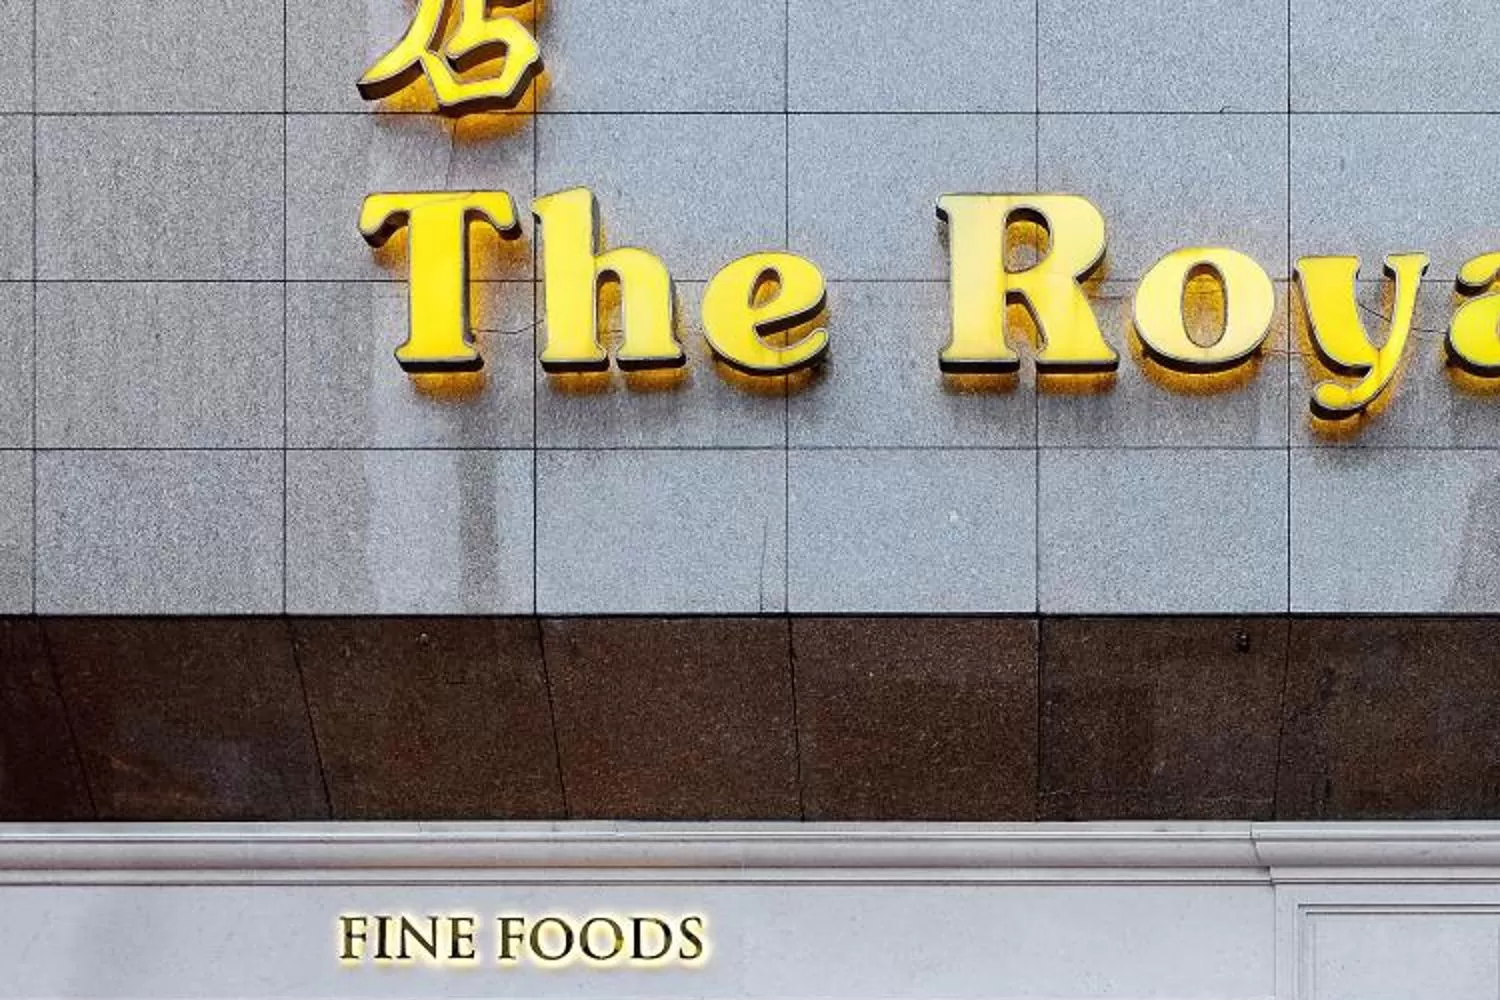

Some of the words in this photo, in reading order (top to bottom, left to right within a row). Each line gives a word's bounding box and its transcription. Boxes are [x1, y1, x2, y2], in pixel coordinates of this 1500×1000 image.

[358, 186, 829, 374] The
[339, 916, 476, 960] FINE
[498, 916, 704, 960] FOODS
